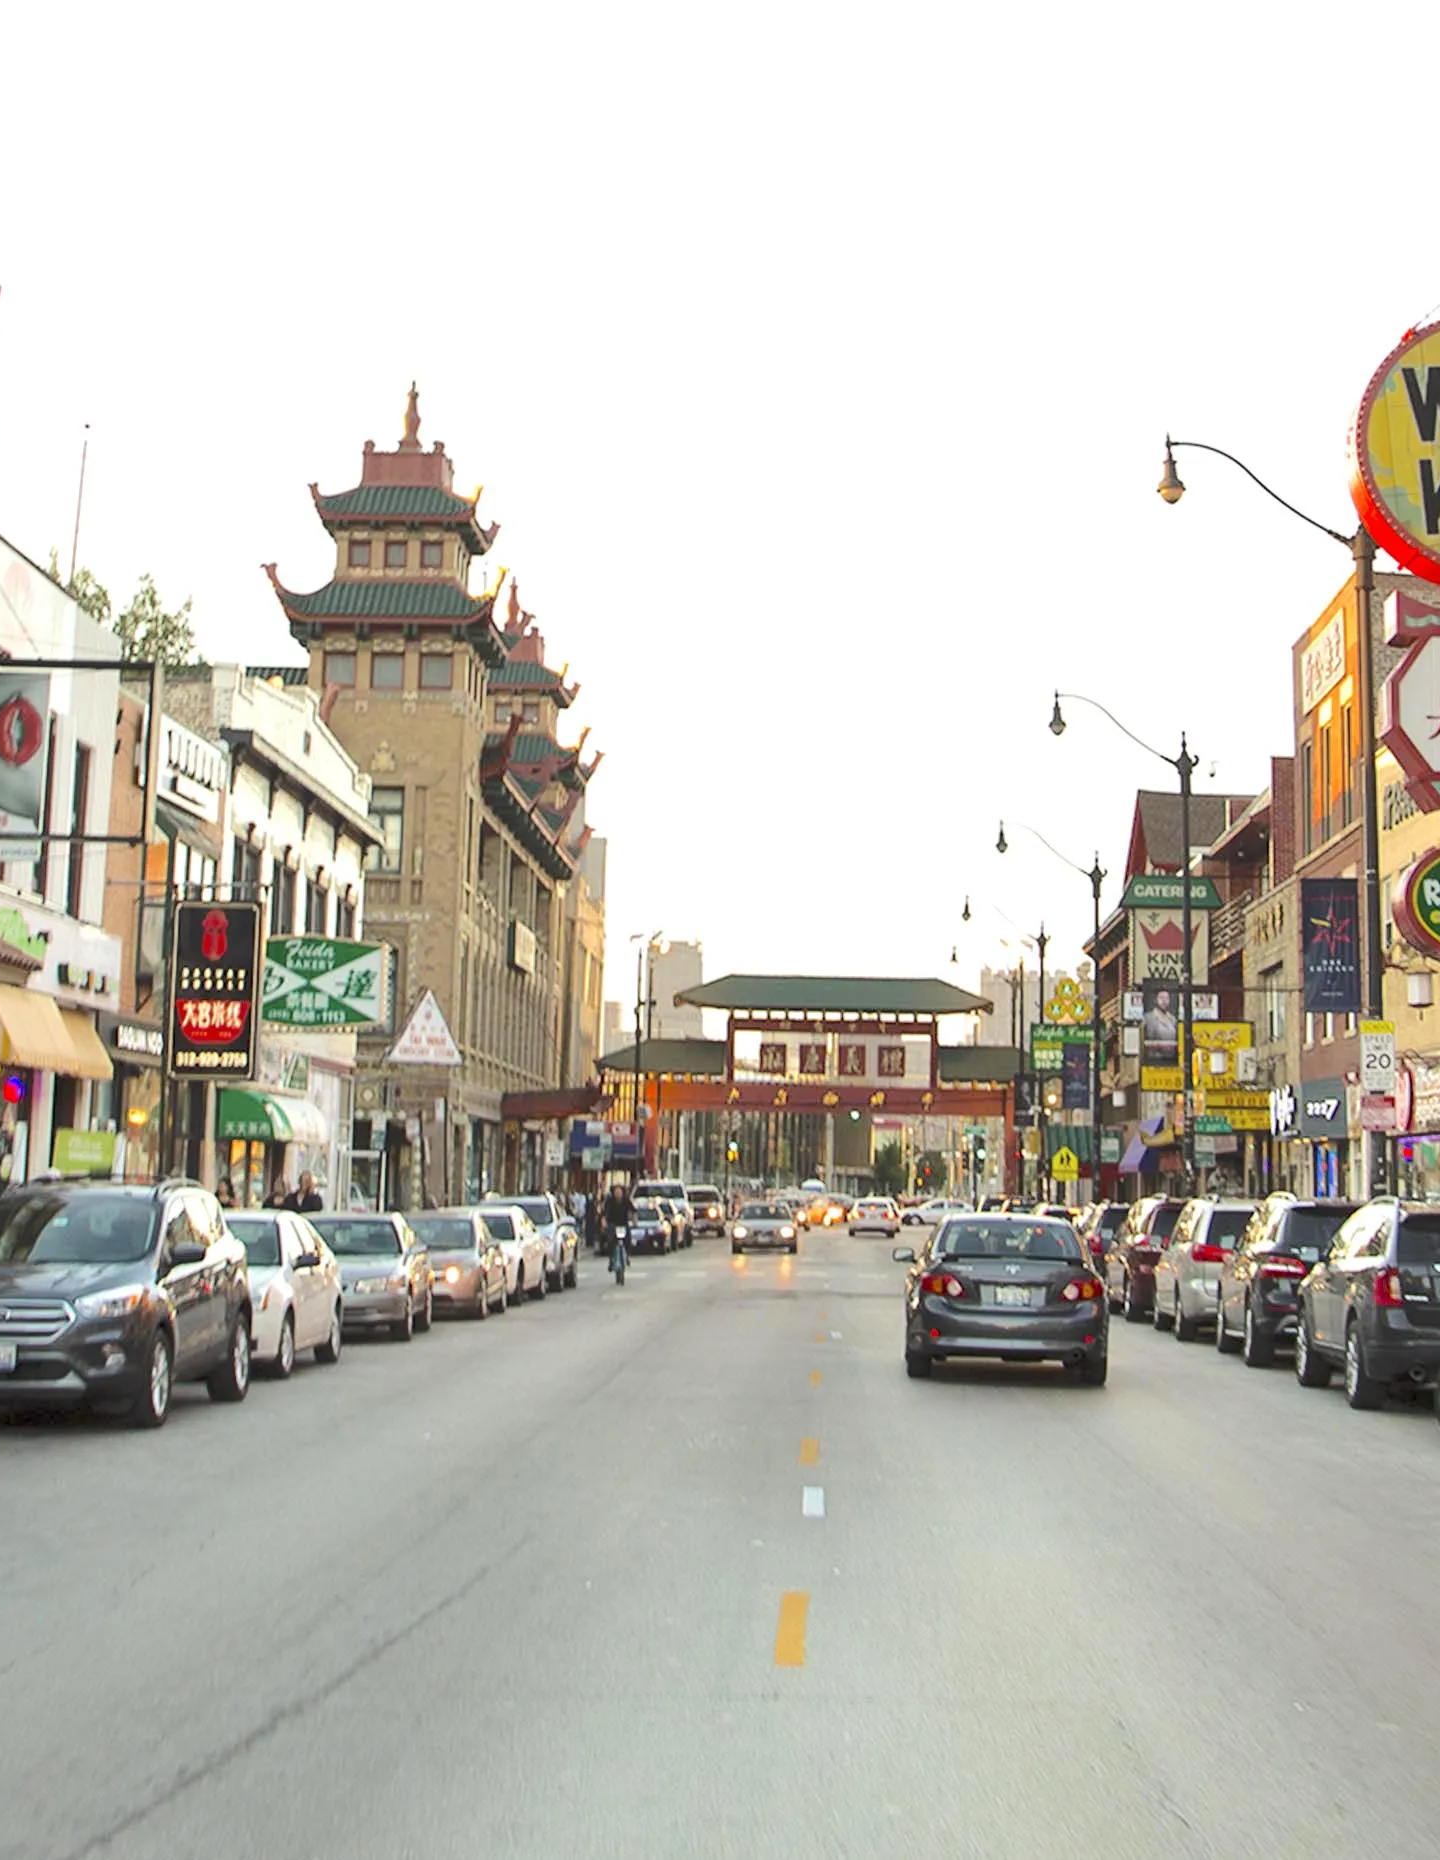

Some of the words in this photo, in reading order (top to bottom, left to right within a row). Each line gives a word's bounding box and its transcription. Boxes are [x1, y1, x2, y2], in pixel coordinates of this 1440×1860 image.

[1133, 884, 1208, 898] CATERNG
[1148, 952, 1186, 965] KIN
[1363, 1035, 1392, 1044] SPEED
[1365, 1044, 1390, 1052] LIMIT
[1365, 1053, 1391, 1069] 20
